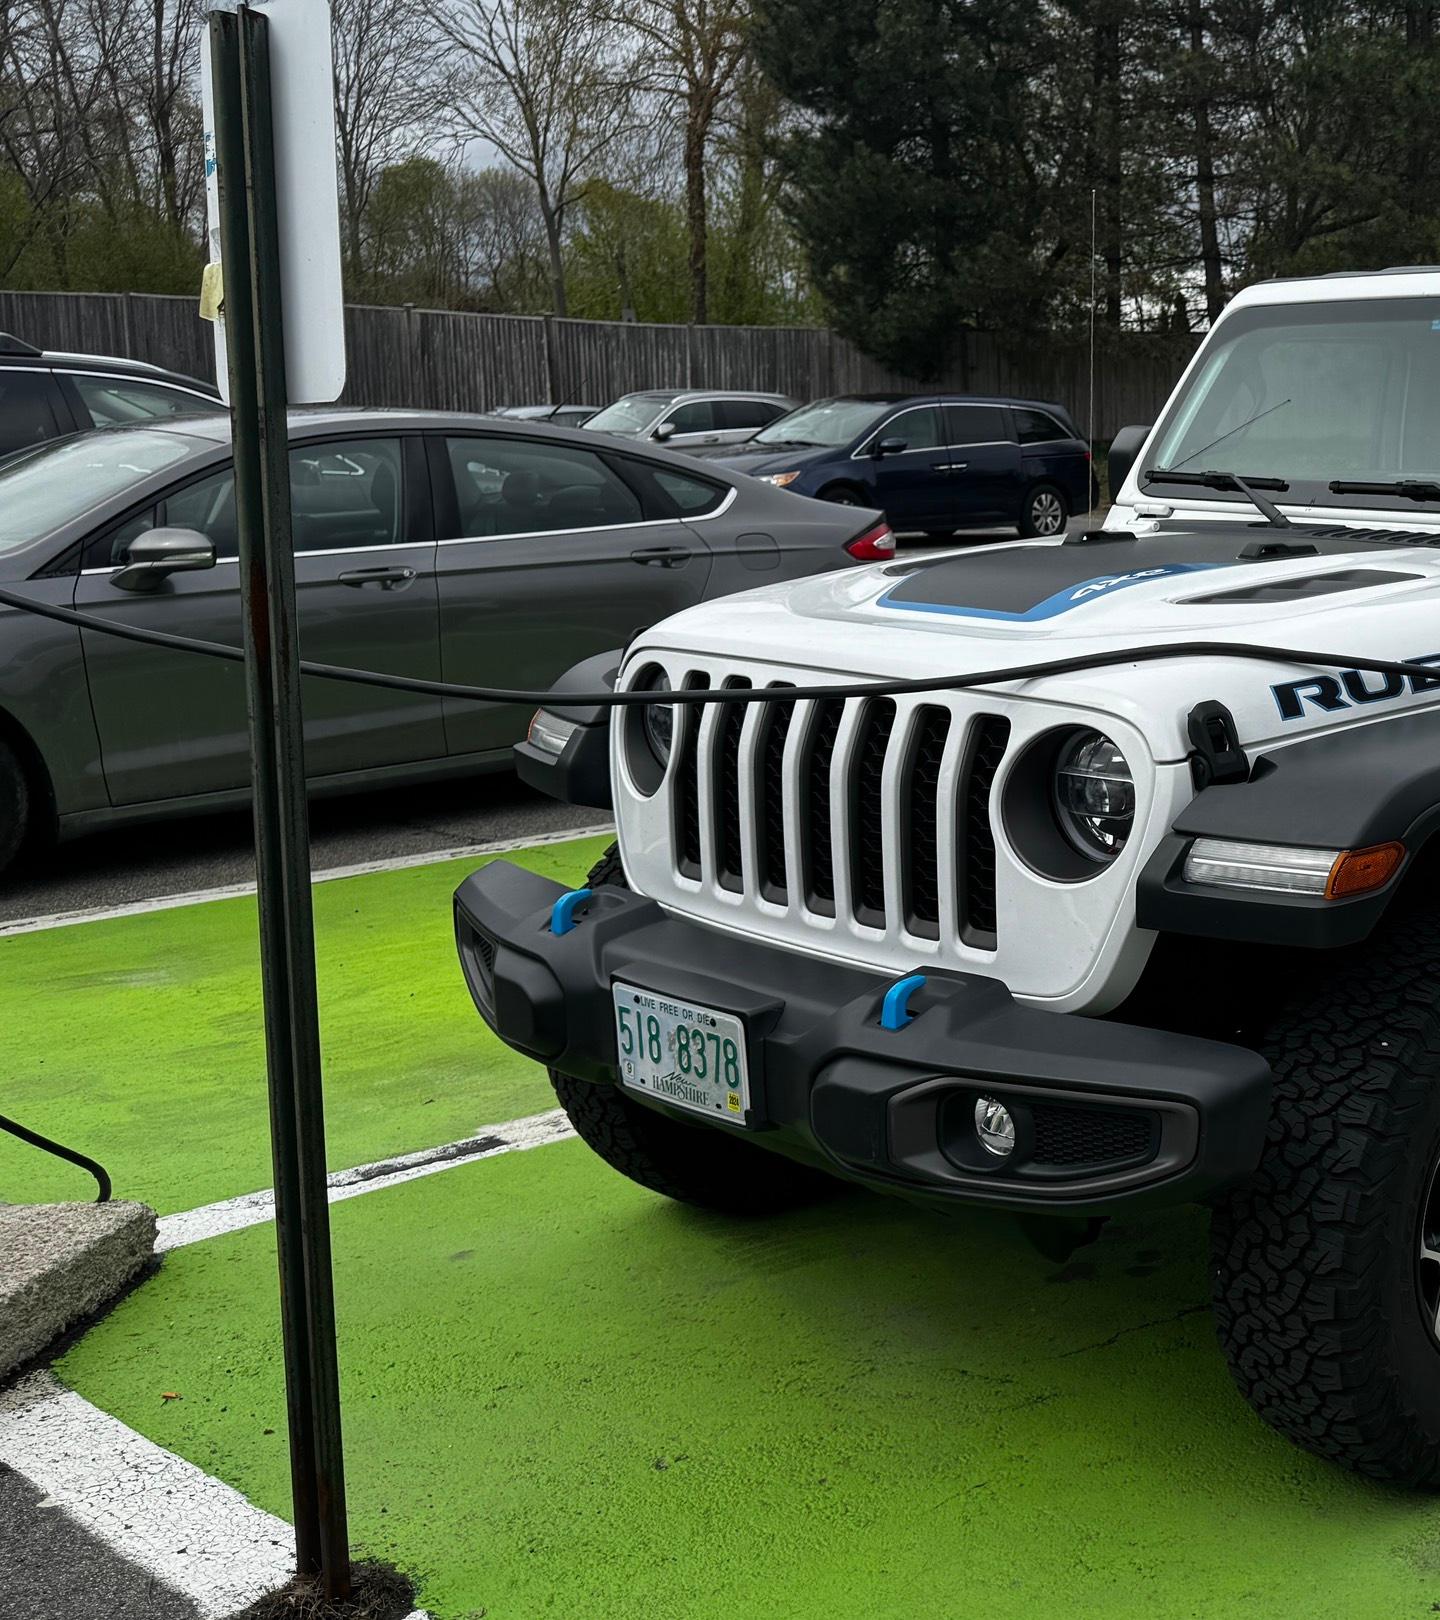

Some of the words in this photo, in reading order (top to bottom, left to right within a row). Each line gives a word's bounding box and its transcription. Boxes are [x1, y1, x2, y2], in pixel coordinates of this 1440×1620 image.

[640, 995, 656, 1010] LIVE
[660, 1002, 679, 1017] FREE
[682, 1008, 694, 1021] OR
[697, 1013, 710, 1026] DIE
[618, 1006, 661, 1064] 518
[677, 1025, 739, 1088] 8378
[626, 1061, 633, 1074] 9
[661, 1071, 697, 1088] New
[652, 1074, 710, 1106] HAMPSHIRE
